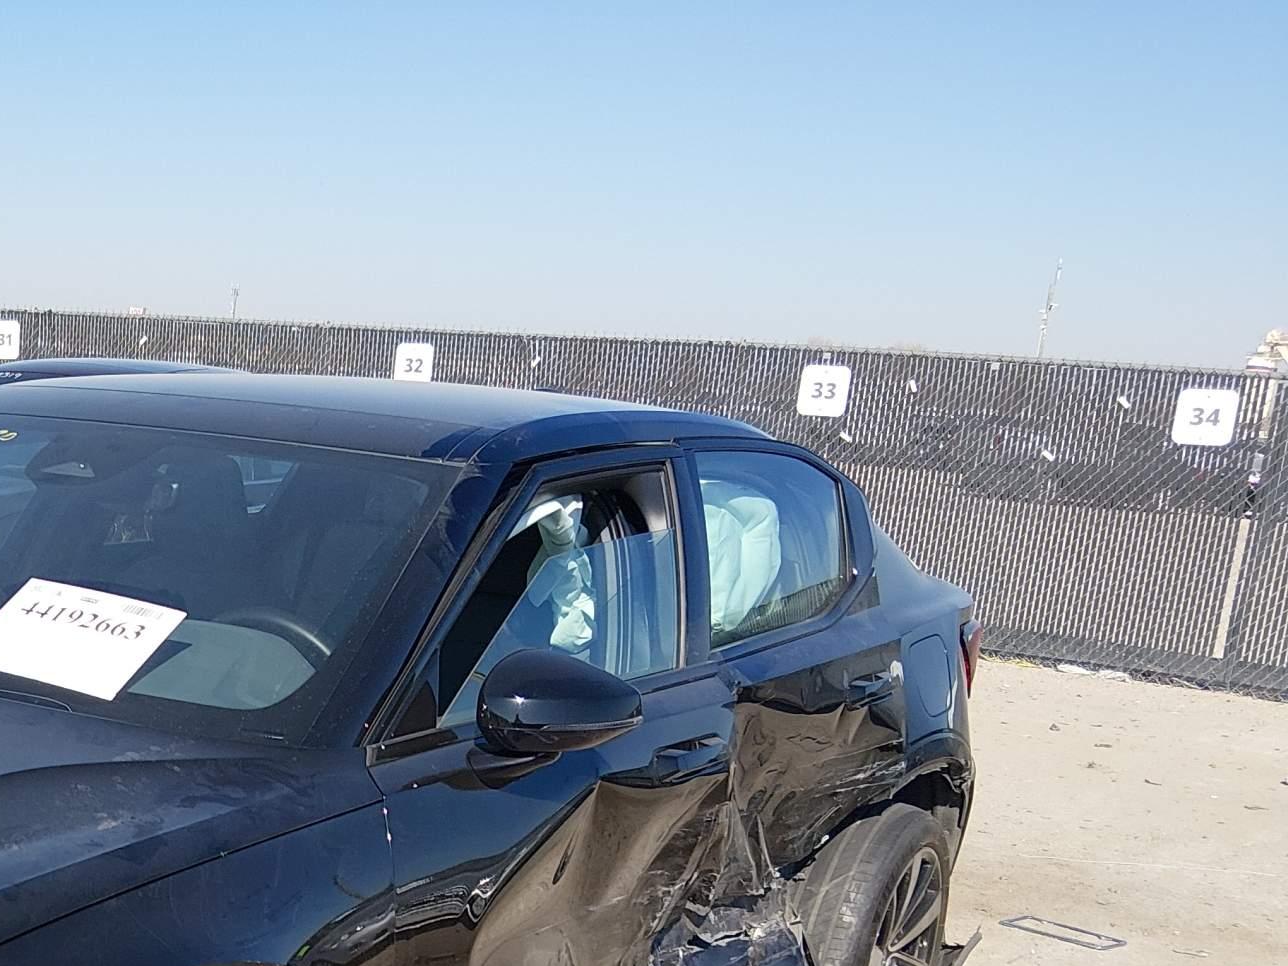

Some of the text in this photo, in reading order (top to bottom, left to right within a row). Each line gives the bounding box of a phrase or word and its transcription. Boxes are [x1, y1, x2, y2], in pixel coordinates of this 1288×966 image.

[404, 358, 424, 373] 32
[811, 382, 837, 399] 33
[1189, 407, 1221, 426] 34
[21, 601, 146, 640] 44192663
